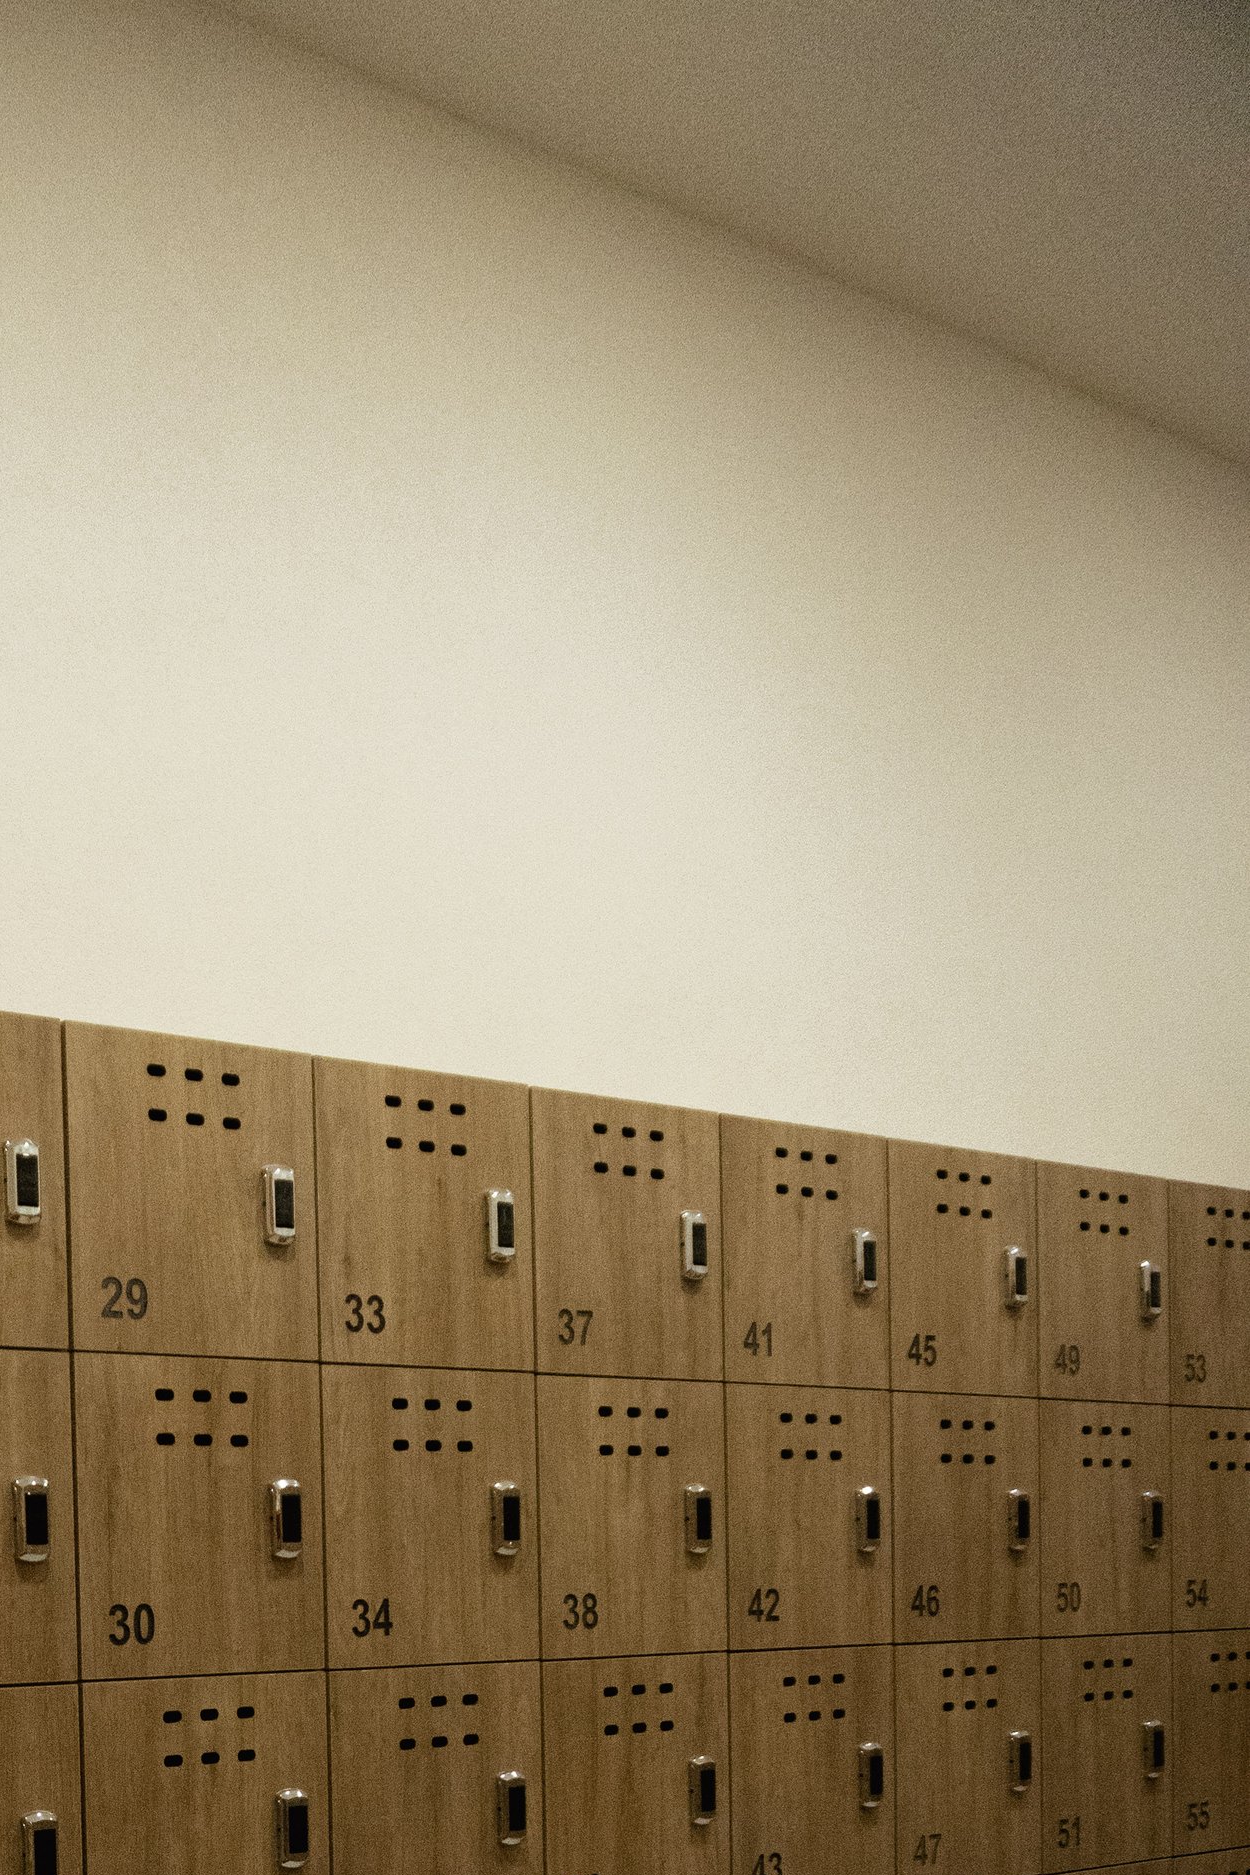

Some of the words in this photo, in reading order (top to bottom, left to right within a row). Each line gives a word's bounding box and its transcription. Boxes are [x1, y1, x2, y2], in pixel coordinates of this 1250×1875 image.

[101, 1277, 149, 1319] 29
[344, 1294, 386, 1334] 33
[558, 1309, 593, 1346] 37
[744, 1322, 773, 1356] 41
[907, 1335, 936, 1367] 45
[1054, 1345, 1080, 1376] 49
[1184, 1354, 1207, 1383] 53
[747, 1588, 779, 1622] 42
[910, 1585, 939, 1617] 46
[1056, 1582, 1080, 1613] 50
[1186, 1579, 1208, 1608] 54
[108, 1604, 156, 1645] 30
[351, 1598, 393, 1638] 34
[563, 1593, 598, 1630] 38
[1186, 1802, 1209, 1831] 55
[1057, 1817, 1080, 1849] 51
[913, 1834, 943, 1866] 47
